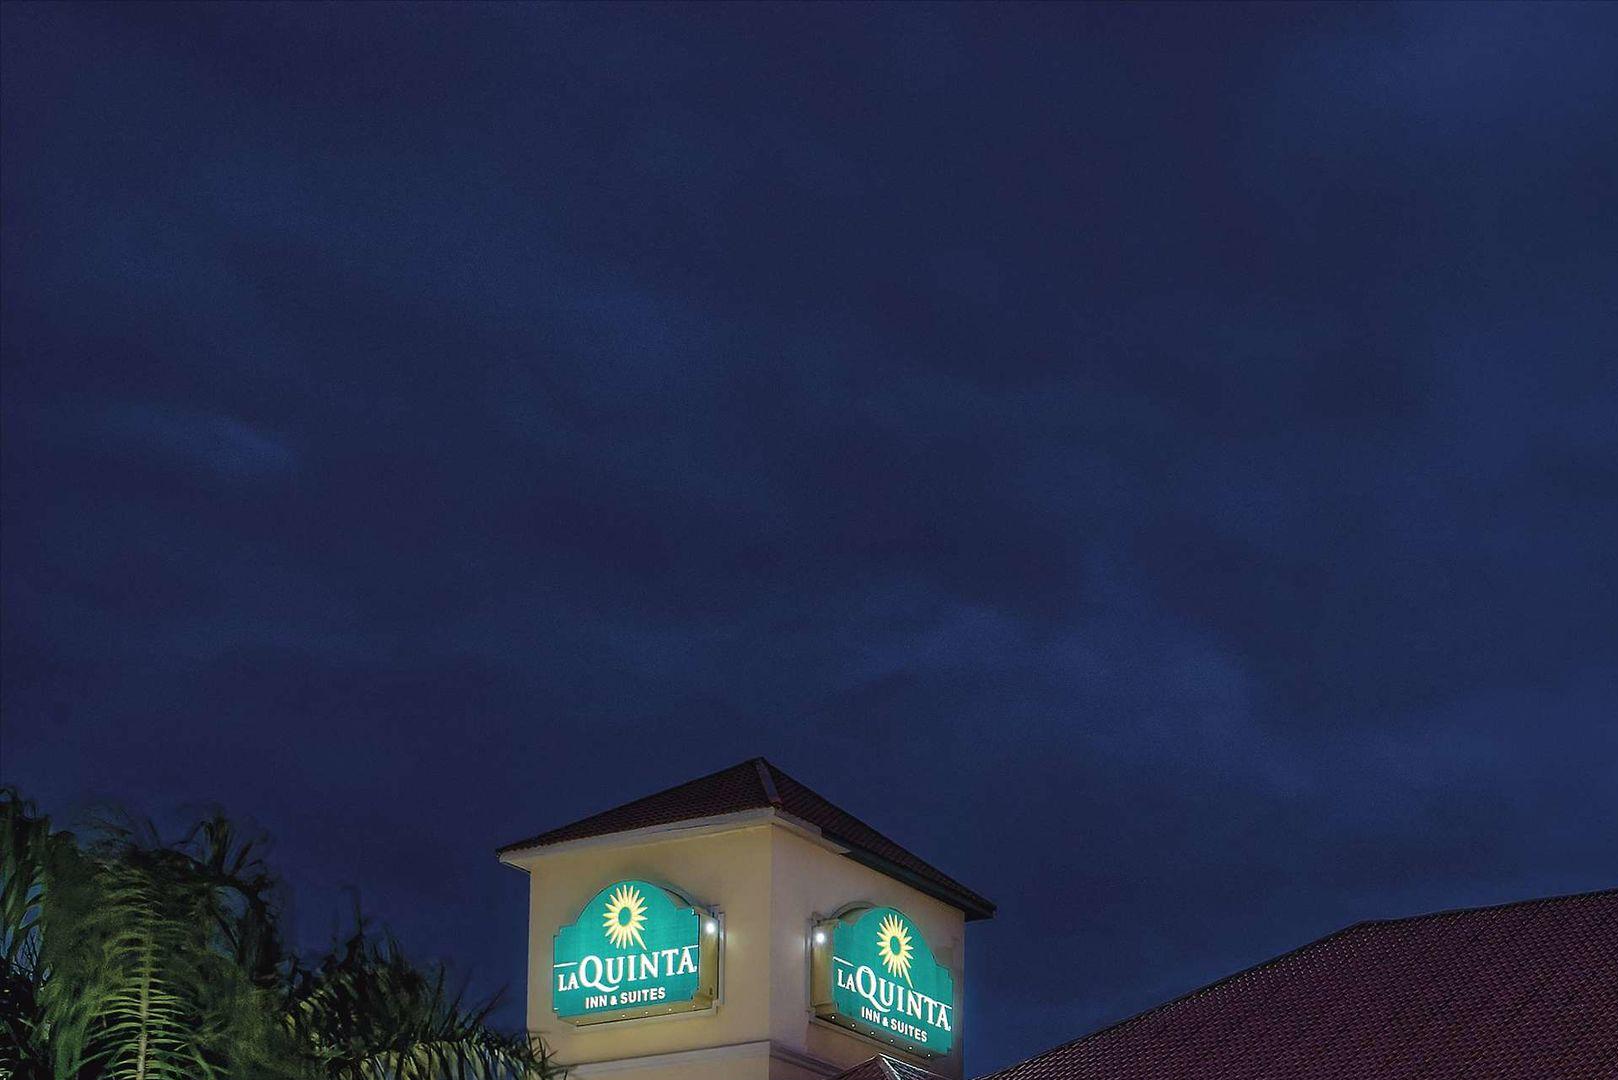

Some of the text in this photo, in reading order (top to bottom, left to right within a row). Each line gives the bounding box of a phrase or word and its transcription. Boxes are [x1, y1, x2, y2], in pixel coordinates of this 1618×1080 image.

[558, 946, 697, 993] LA QUINTA
[585, 986, 666, 1009] INN & SUITES
[837, 965, 952, 1032] LA QUINTA
[861, 1006, 928, 1043] INN & SUITES
